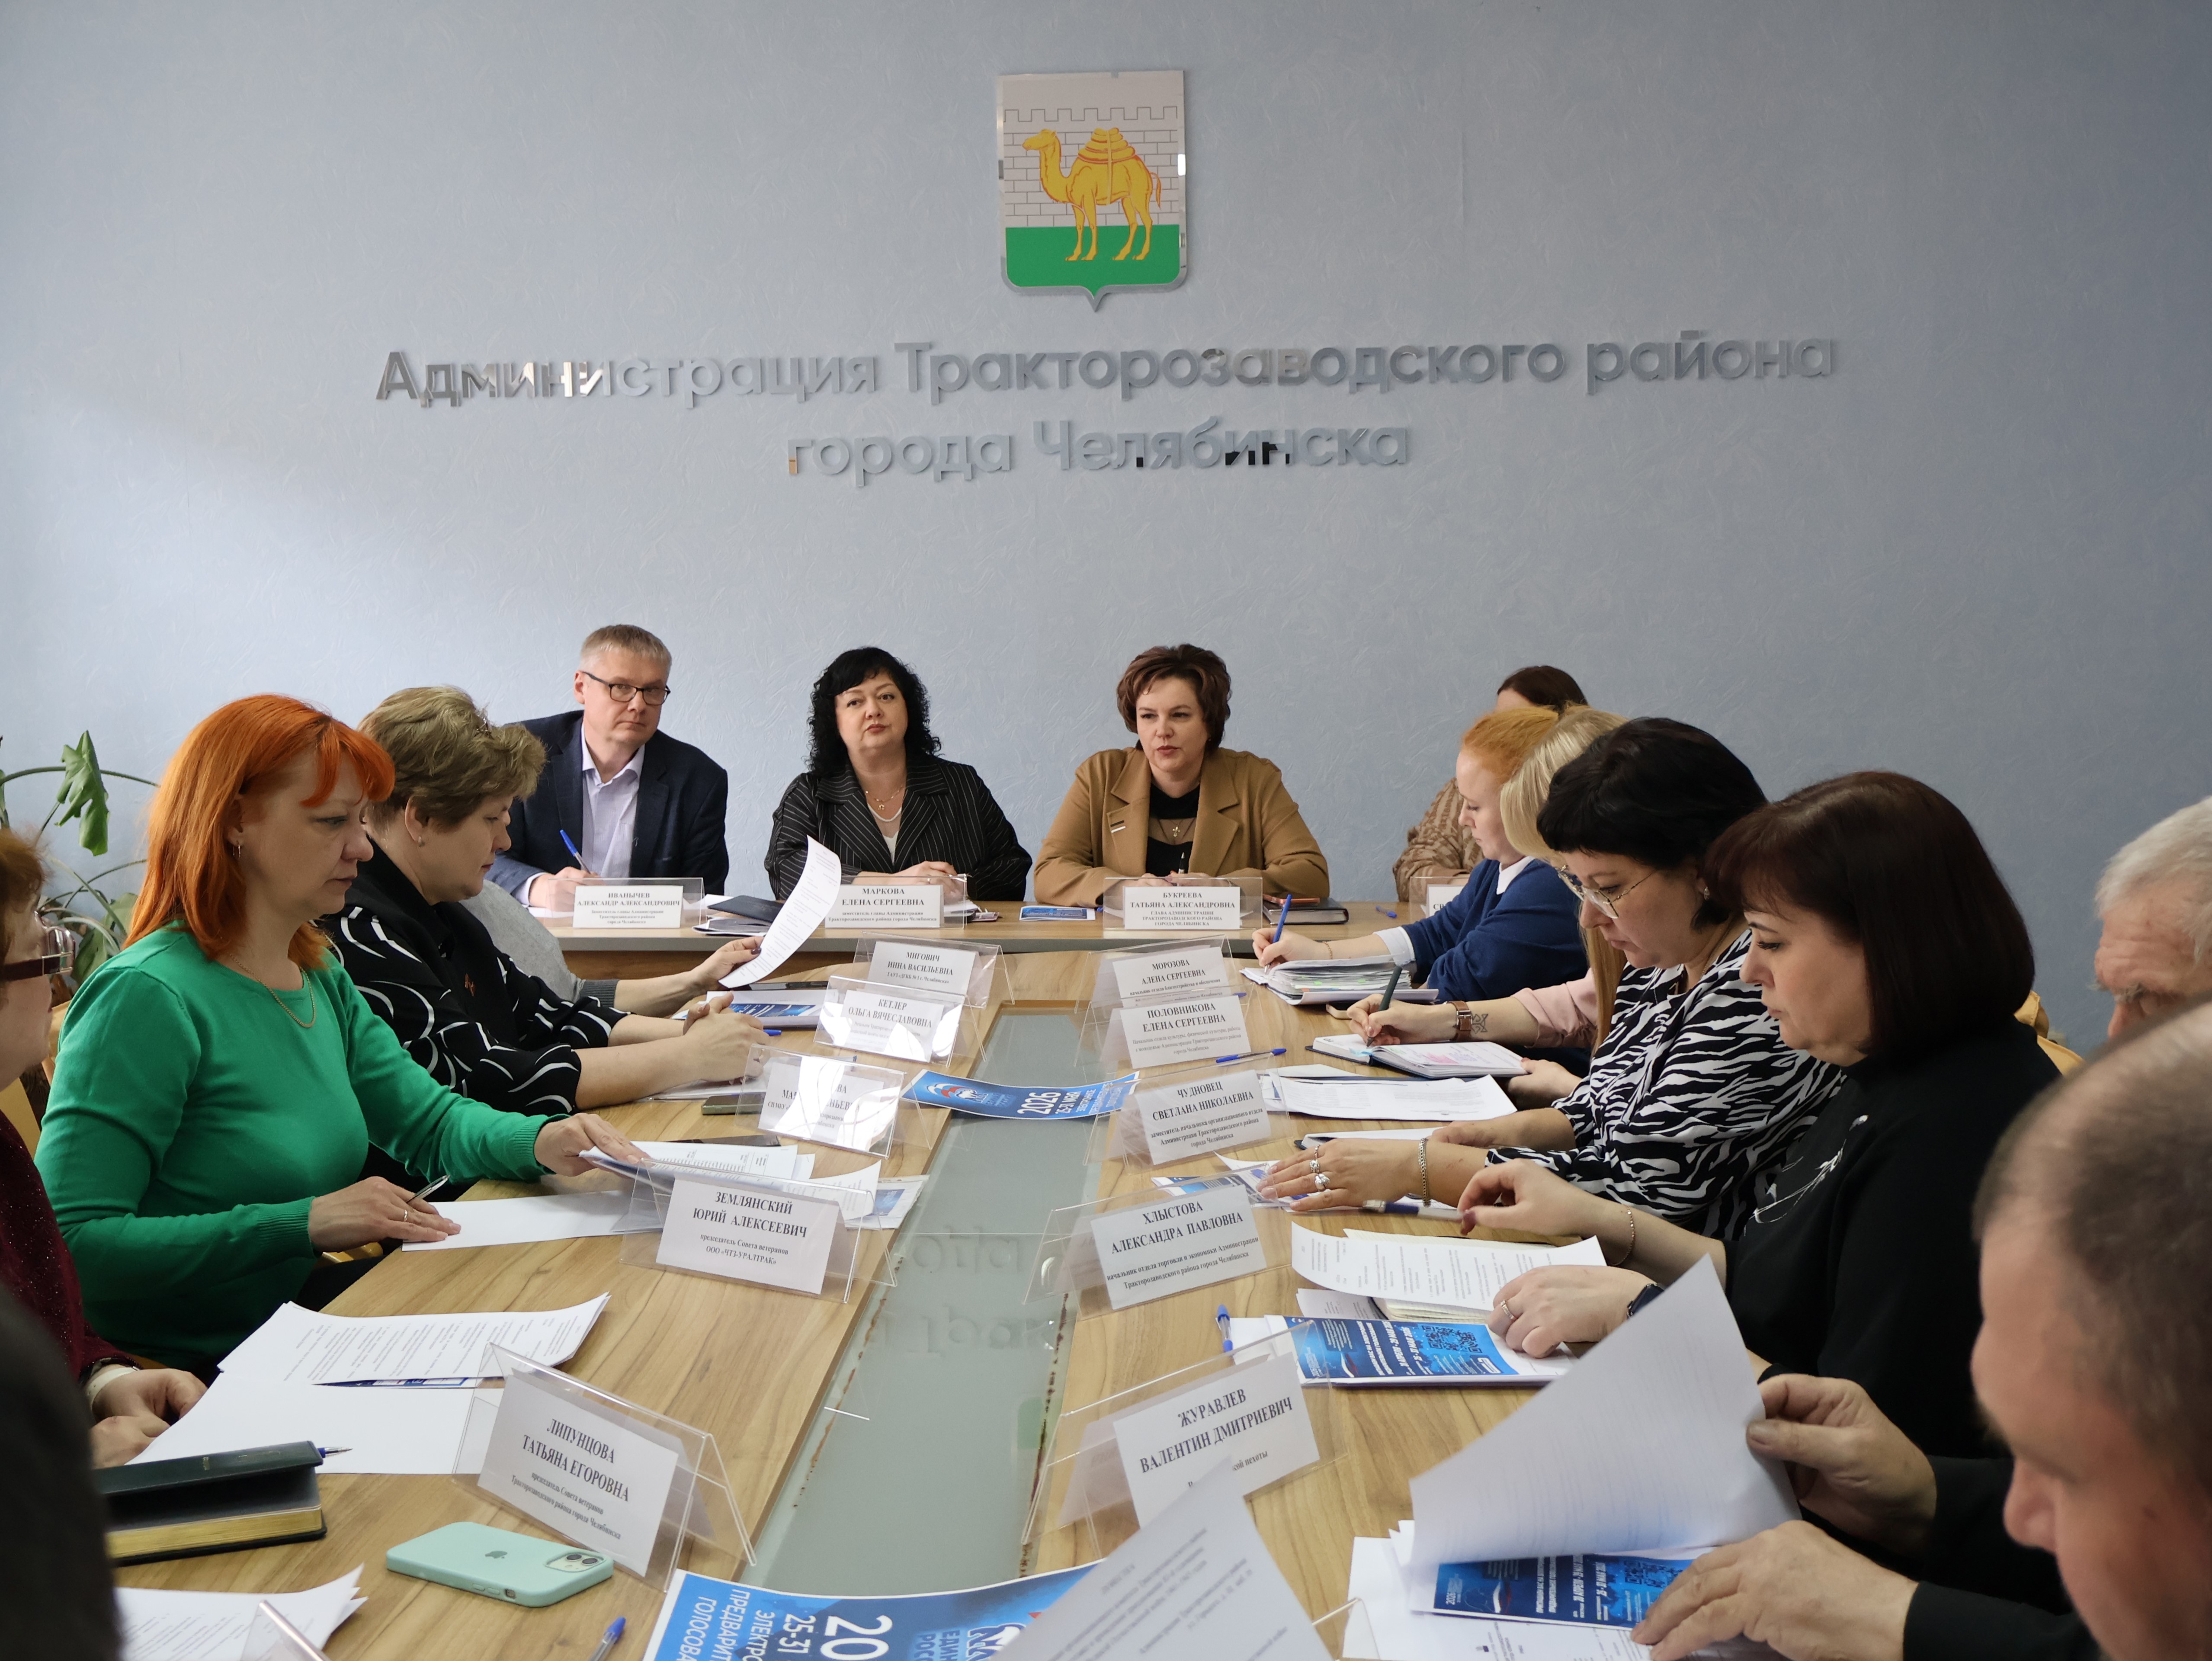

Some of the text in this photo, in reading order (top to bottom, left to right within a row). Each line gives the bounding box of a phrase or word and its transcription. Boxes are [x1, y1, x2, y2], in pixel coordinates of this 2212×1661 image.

[375, 330, 1836, 408] Администрация Тракторозаводского района
[789, 417, 1408, 487] города Челябинска
[888, 961, 953, 975] ИННА ВАСИЛЬЕВНА
[906, 952, 940, 962] МИГОВИЧ
[1152, 959, 1190, 971] МОРОЗОВА
[1141, 969, 1206, 985] АЛЕНА СЕРГЕЕВНА
[878, 999, 907, 1010] КЕТЛЕР
[1147, 1003, 1216, 1019] ПОЛОВНИКОВА
[849, 1007, 871, 1018] ОЛЬГА
[872, 1011, 932, 1028] ВЯЧЕСЛАВОВНА
[1143, 1015, 1225, 1033] ЕЛЕНА СЕРГЕЕВНА
[1177, 1081, 1223, 1098] ЧУДНОВЕЦ
[1017, 1092, 1061, 1115] 2026
[1055, 1091, 1082, 1114] 25-31 мая
[1153, 1091, 1254, 1121] СВЕТЛАНА НИКОЛАЕВНА
[1151, 1127, 1180, 1138] заместитель
[1180, 1122, 1208, 1132] начальника
[1160, 1133, 1197, 1145] Администрации
[1243, 1118, 1259, 1127] района
[715, 1191, 793, 1215] ЗЕМЛЯНСКИЙ
[1143, 1201, 1203, 1225] ХЛЫСТОВА
[693, 1208, 808, 1238] ЮРИЙ АЛЕКСЕЕВИЧ
[1112, 1212, 1243, 1254] АЛЕКСАНДРА ПАВЛОВНА
[700, 1234, 789, 1255] председатель Совета ветеранов
[706, 1246, 777, 1265] ООО «ЧТЗ-УРАЛТРАК»
[1107, 1268, 1138, 1281] начальник
[1138, 1263, 1157, 1273] отдела
[1158, 1257, 1183, 1270] торговли
[1188, 1247, 1218, 1260] экономики
[1218, 1236, 1259, 1253] Администрации
[1123, 1251, 1249, 1290] Тракторозаводского района города Челябинска
[1178, 1388, 1246, 1427] ЖУРАВЛЕВ
[547, 1418, 615, 1464] ЛИПУНЦОВА
[1140, 1397, 1293, 1473] ВАЛЕНТИН ДМИТРИЕВИЧ
[522, 1435, 629, 1502] ТАТЬЯНА ЕГОРОВНА
[1245, 1450, 1268, 1467] пехоты
[532, 1472, 604, 1515] председатель Совета ветеранов
[572, 1509, 589, 1525] города
[676, 1596, 718, 1661] ГОЛОСОВА
[709, 1589, 751, 1661] ПРЕДВАРИТ
[742, 1609, 776, 1661] ЭЛЕКТРО
[777, 1613, 816, 1654] 25-31
